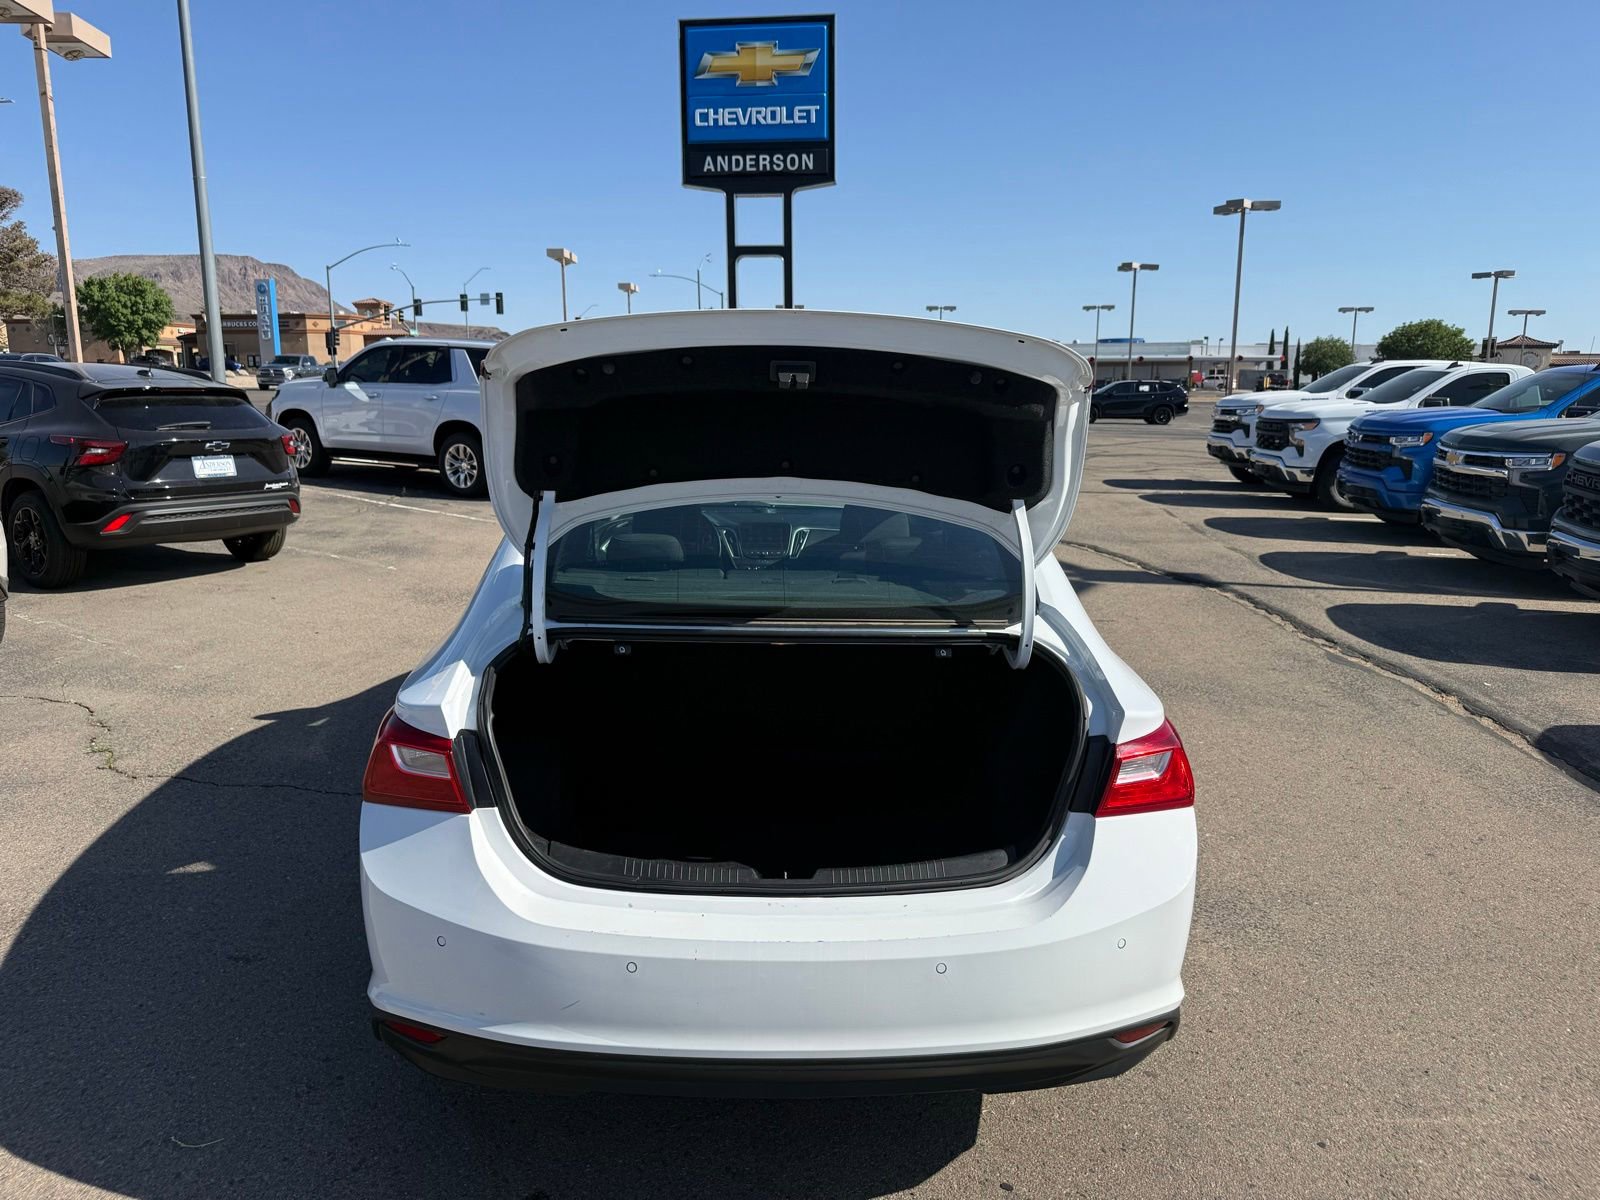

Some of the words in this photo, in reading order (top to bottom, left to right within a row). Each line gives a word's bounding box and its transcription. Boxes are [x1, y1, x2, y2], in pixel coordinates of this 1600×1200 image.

[694, 105, 820, 127] CHEVROLET
[703, 153, 814, 172] ANDERSON
[259, 295, 271, 340] CHASE
